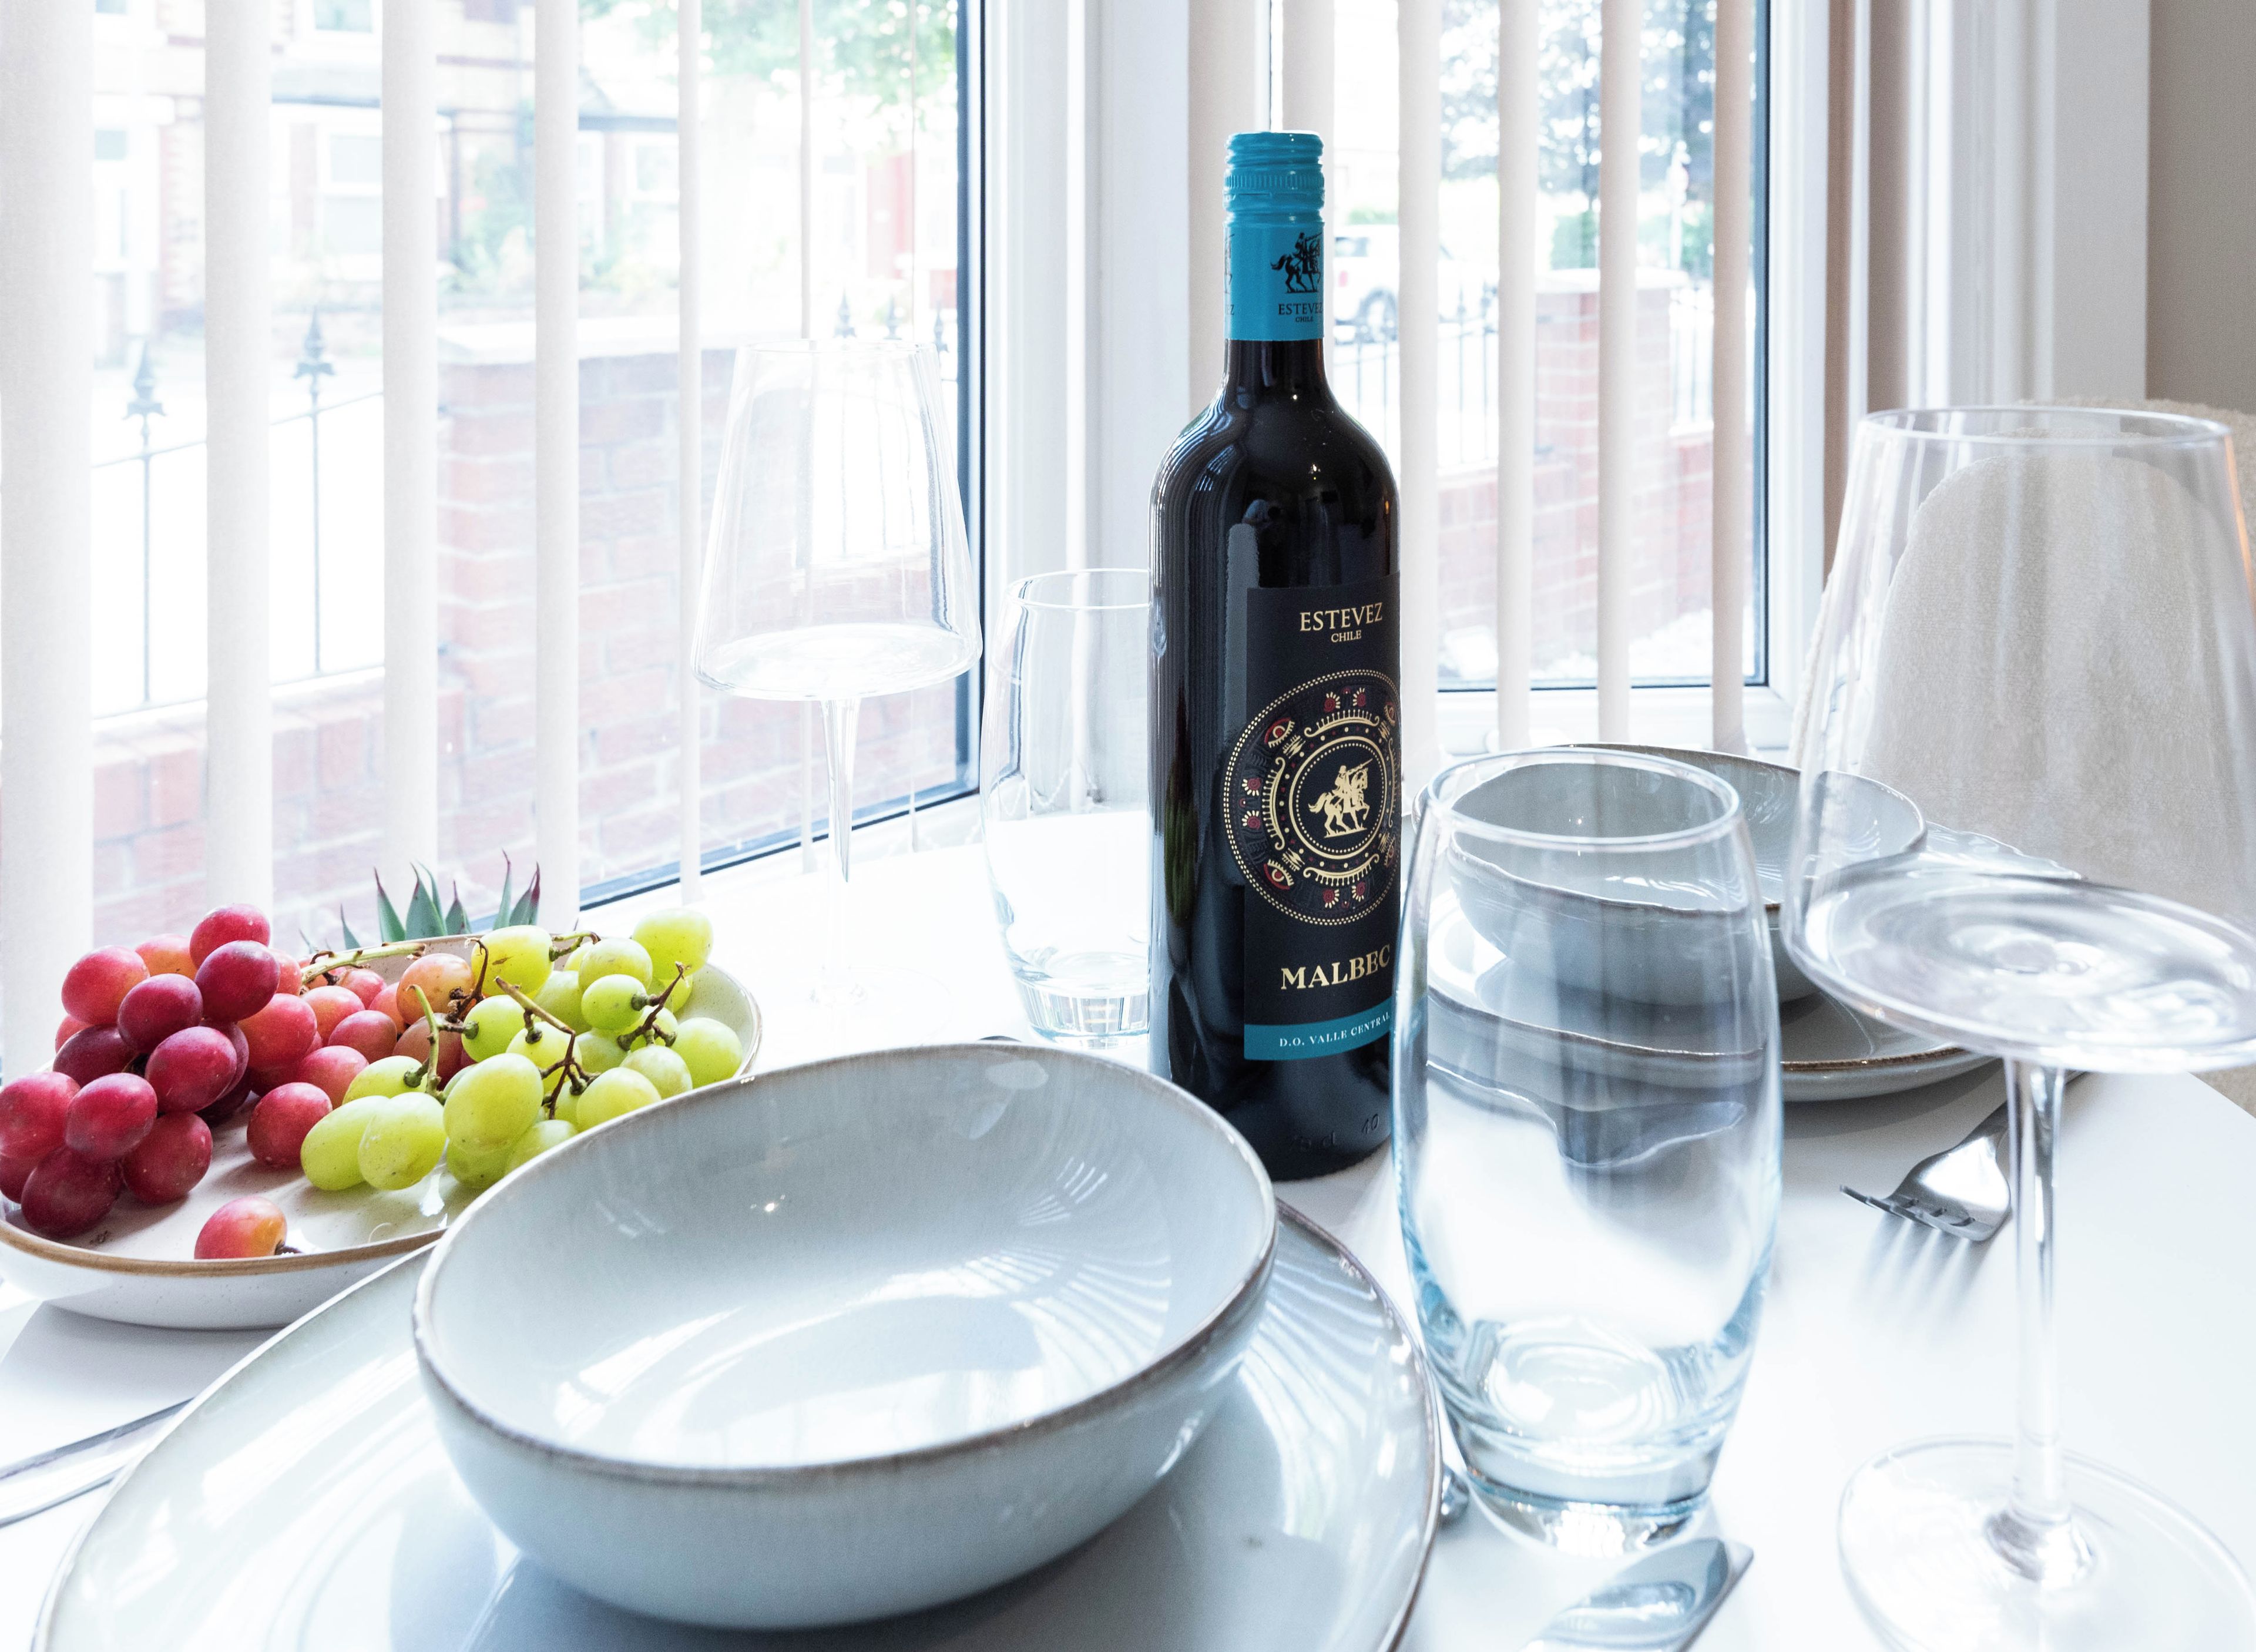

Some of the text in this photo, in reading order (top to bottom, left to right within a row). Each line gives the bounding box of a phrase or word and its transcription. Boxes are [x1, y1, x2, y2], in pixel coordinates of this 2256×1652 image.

[1300, 602, 1383, 632] ESTEVEZ
[1331, 630, 1362, 643] CHILE
[1281, 944, 1390, 990] MALBEC
[1280, 1012, 1390, 1047] D.O. VALLE CENTRAL
